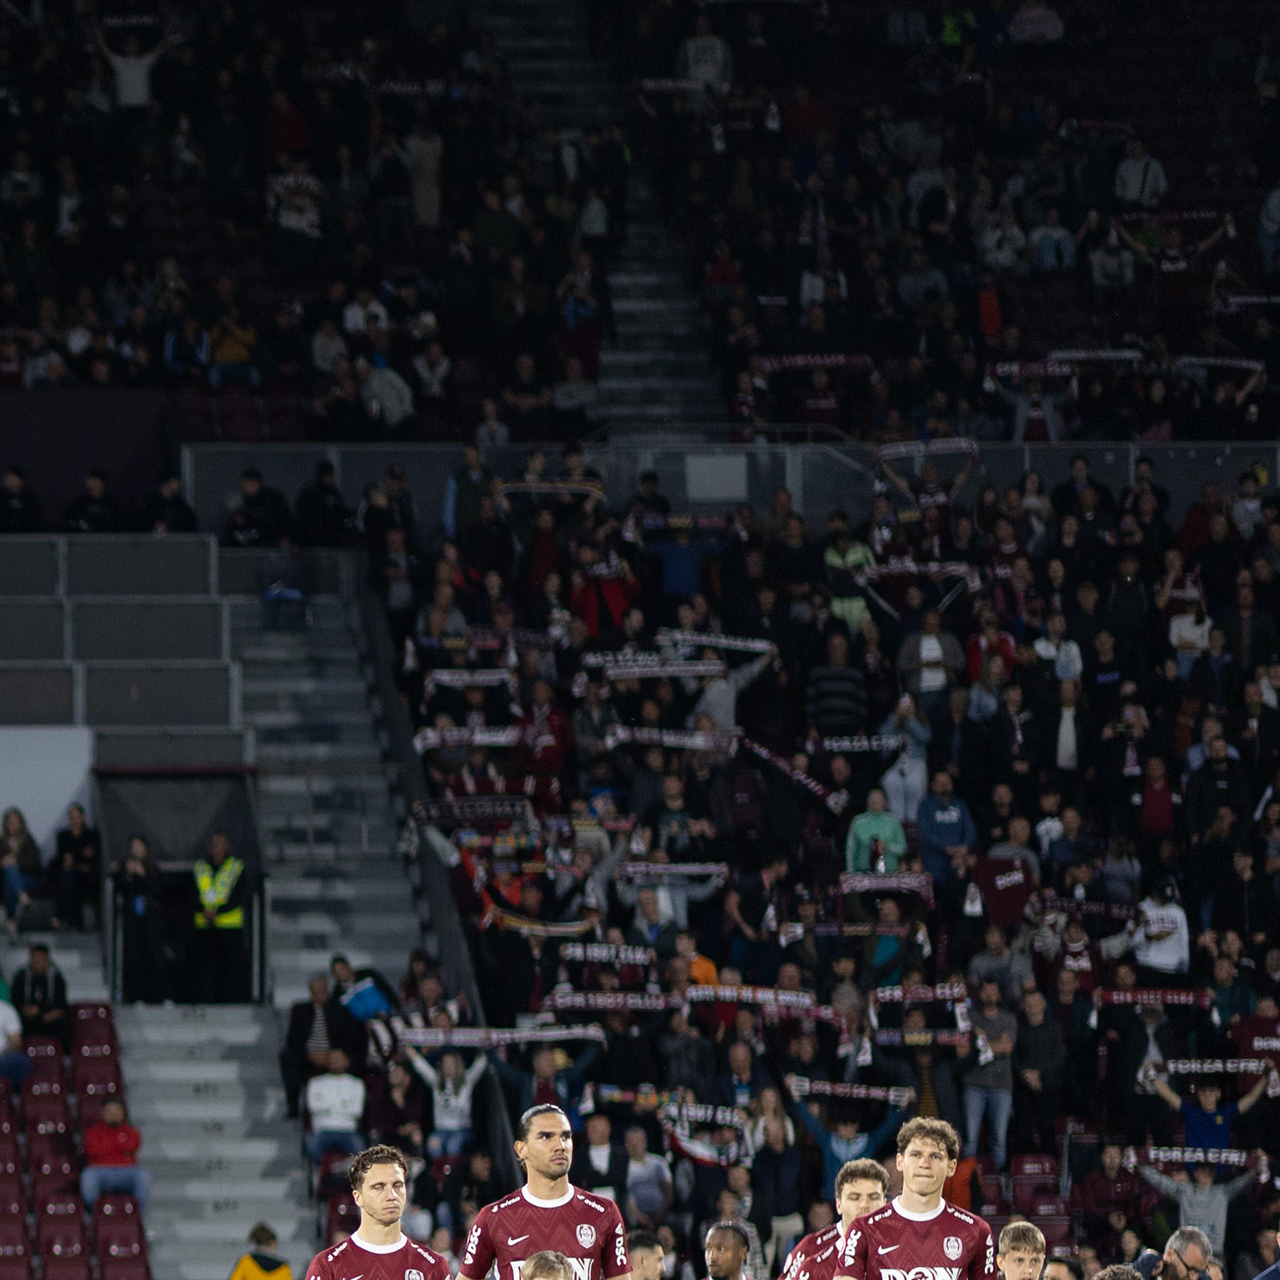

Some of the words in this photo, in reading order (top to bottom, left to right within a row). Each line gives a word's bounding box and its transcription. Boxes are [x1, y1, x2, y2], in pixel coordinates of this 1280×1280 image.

[466, 1225, 481, 1256] DSC
[615, 1236, 627, 1266] DSC
[847, 1229, 862, 1258] DSC
[984, 1246, 994, 1275] DSC
